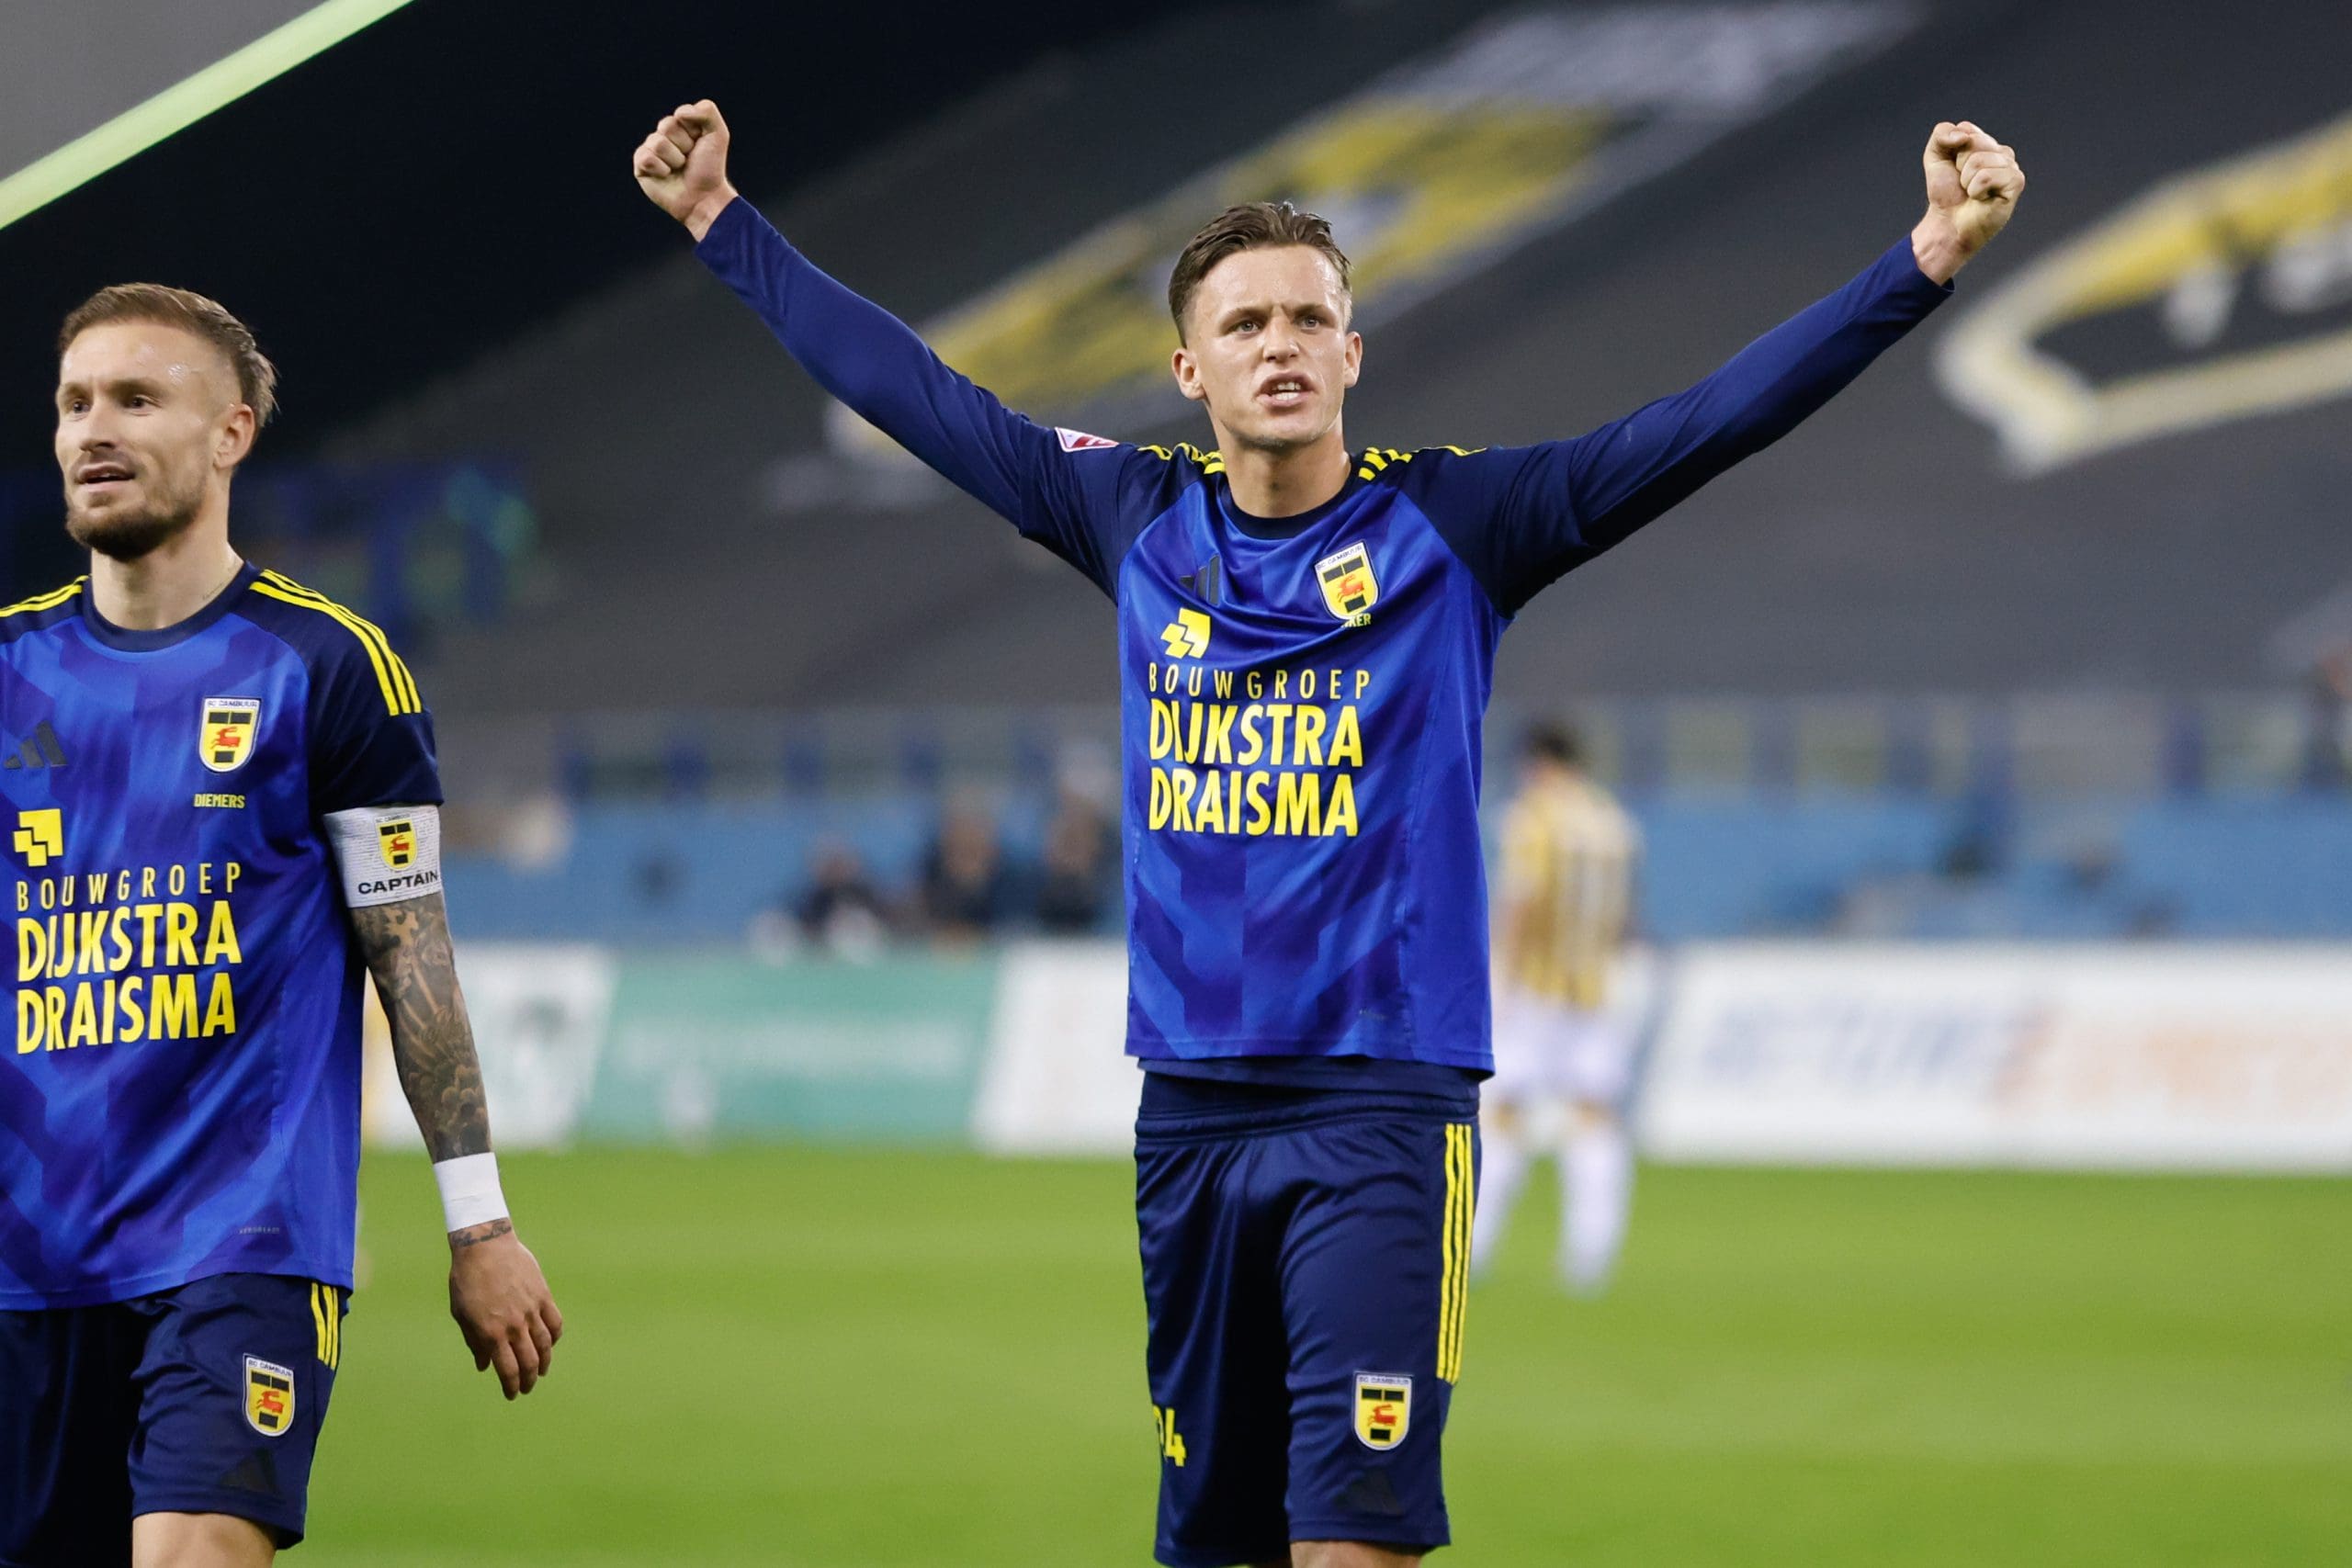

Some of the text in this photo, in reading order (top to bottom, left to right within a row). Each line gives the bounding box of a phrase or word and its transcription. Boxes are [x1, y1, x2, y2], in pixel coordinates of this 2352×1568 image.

[1148, 662, 1370, 700] BOUWGROEP
[1148, 698, 1364, 767] DIJKSTRA
[194, 793, 245, 808] DIEMERS
[1148, 767, 1359, 837] DRAISMA
[17, 862, 242, 910] BOUWGROEP
[357, 870, 438, 895] CAPTAIN
[17, 900, 243, 982] DIJKSTRA
[17, 972, 236, 1055] DRAISMA
